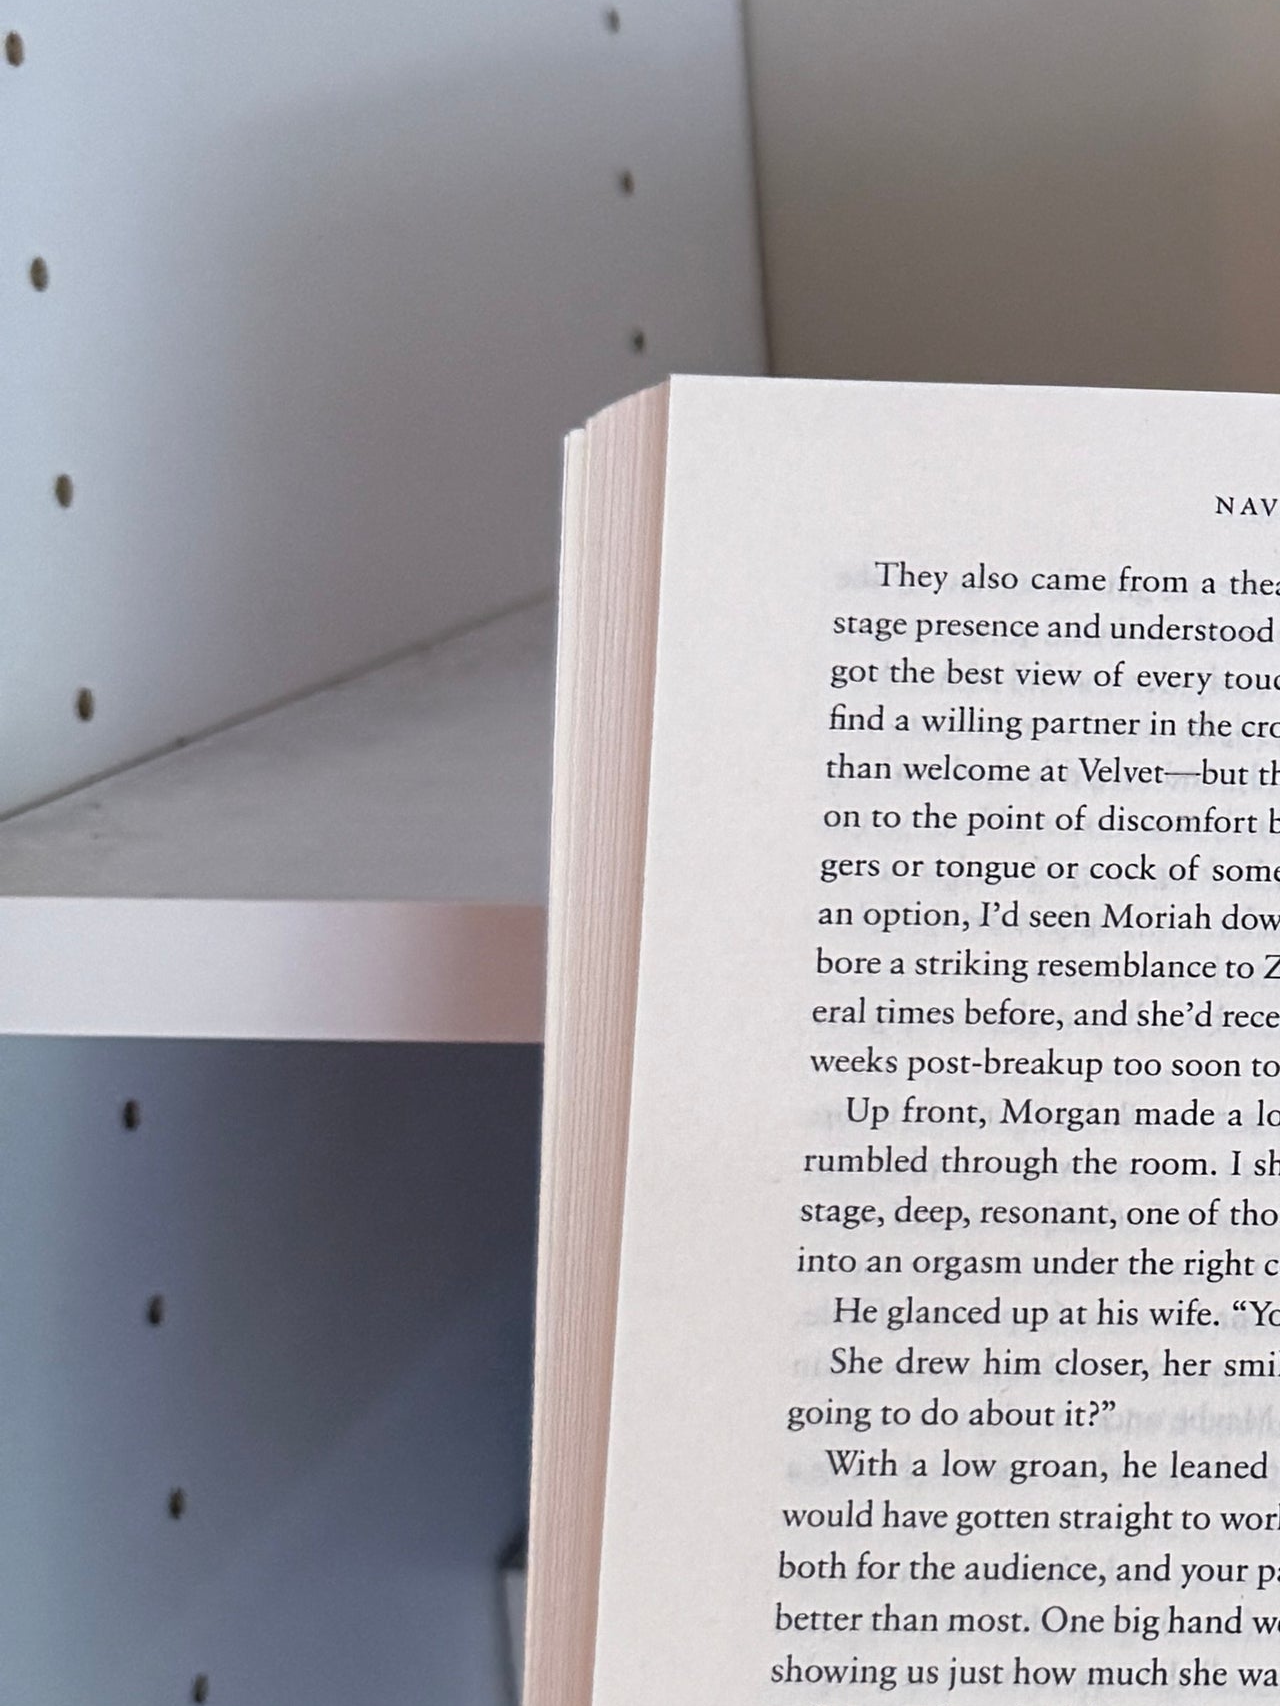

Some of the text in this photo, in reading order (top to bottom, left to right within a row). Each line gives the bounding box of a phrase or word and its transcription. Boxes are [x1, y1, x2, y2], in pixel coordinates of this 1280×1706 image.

[873, 559, 950, 596] They
[960, 561, 1020, 591] also
[1030, 572, 1108, 593] came
[1116, 564, 1190, 595] from
[1200, 576, 1217, 596] a
[827, 701, 885, 732] find
[893, 713, 911, 733] a
[920, 704, 1024, 742] willing
[1029, 715, 1142, 743] partner
[1148, 709, 1178, 737] in
[1186, 708, 1233, 739] the
[799, 1202, 886, 1231] stage,
[893, 1194, 972, 1232] deep,
[978, 1204, 1118, 1231] resonant,
[1125, 1206, 1181, 1227] one
[1187, 1196, 1222, 1227] of
[785, 1395, 1117, 1434] going to do about it?”
